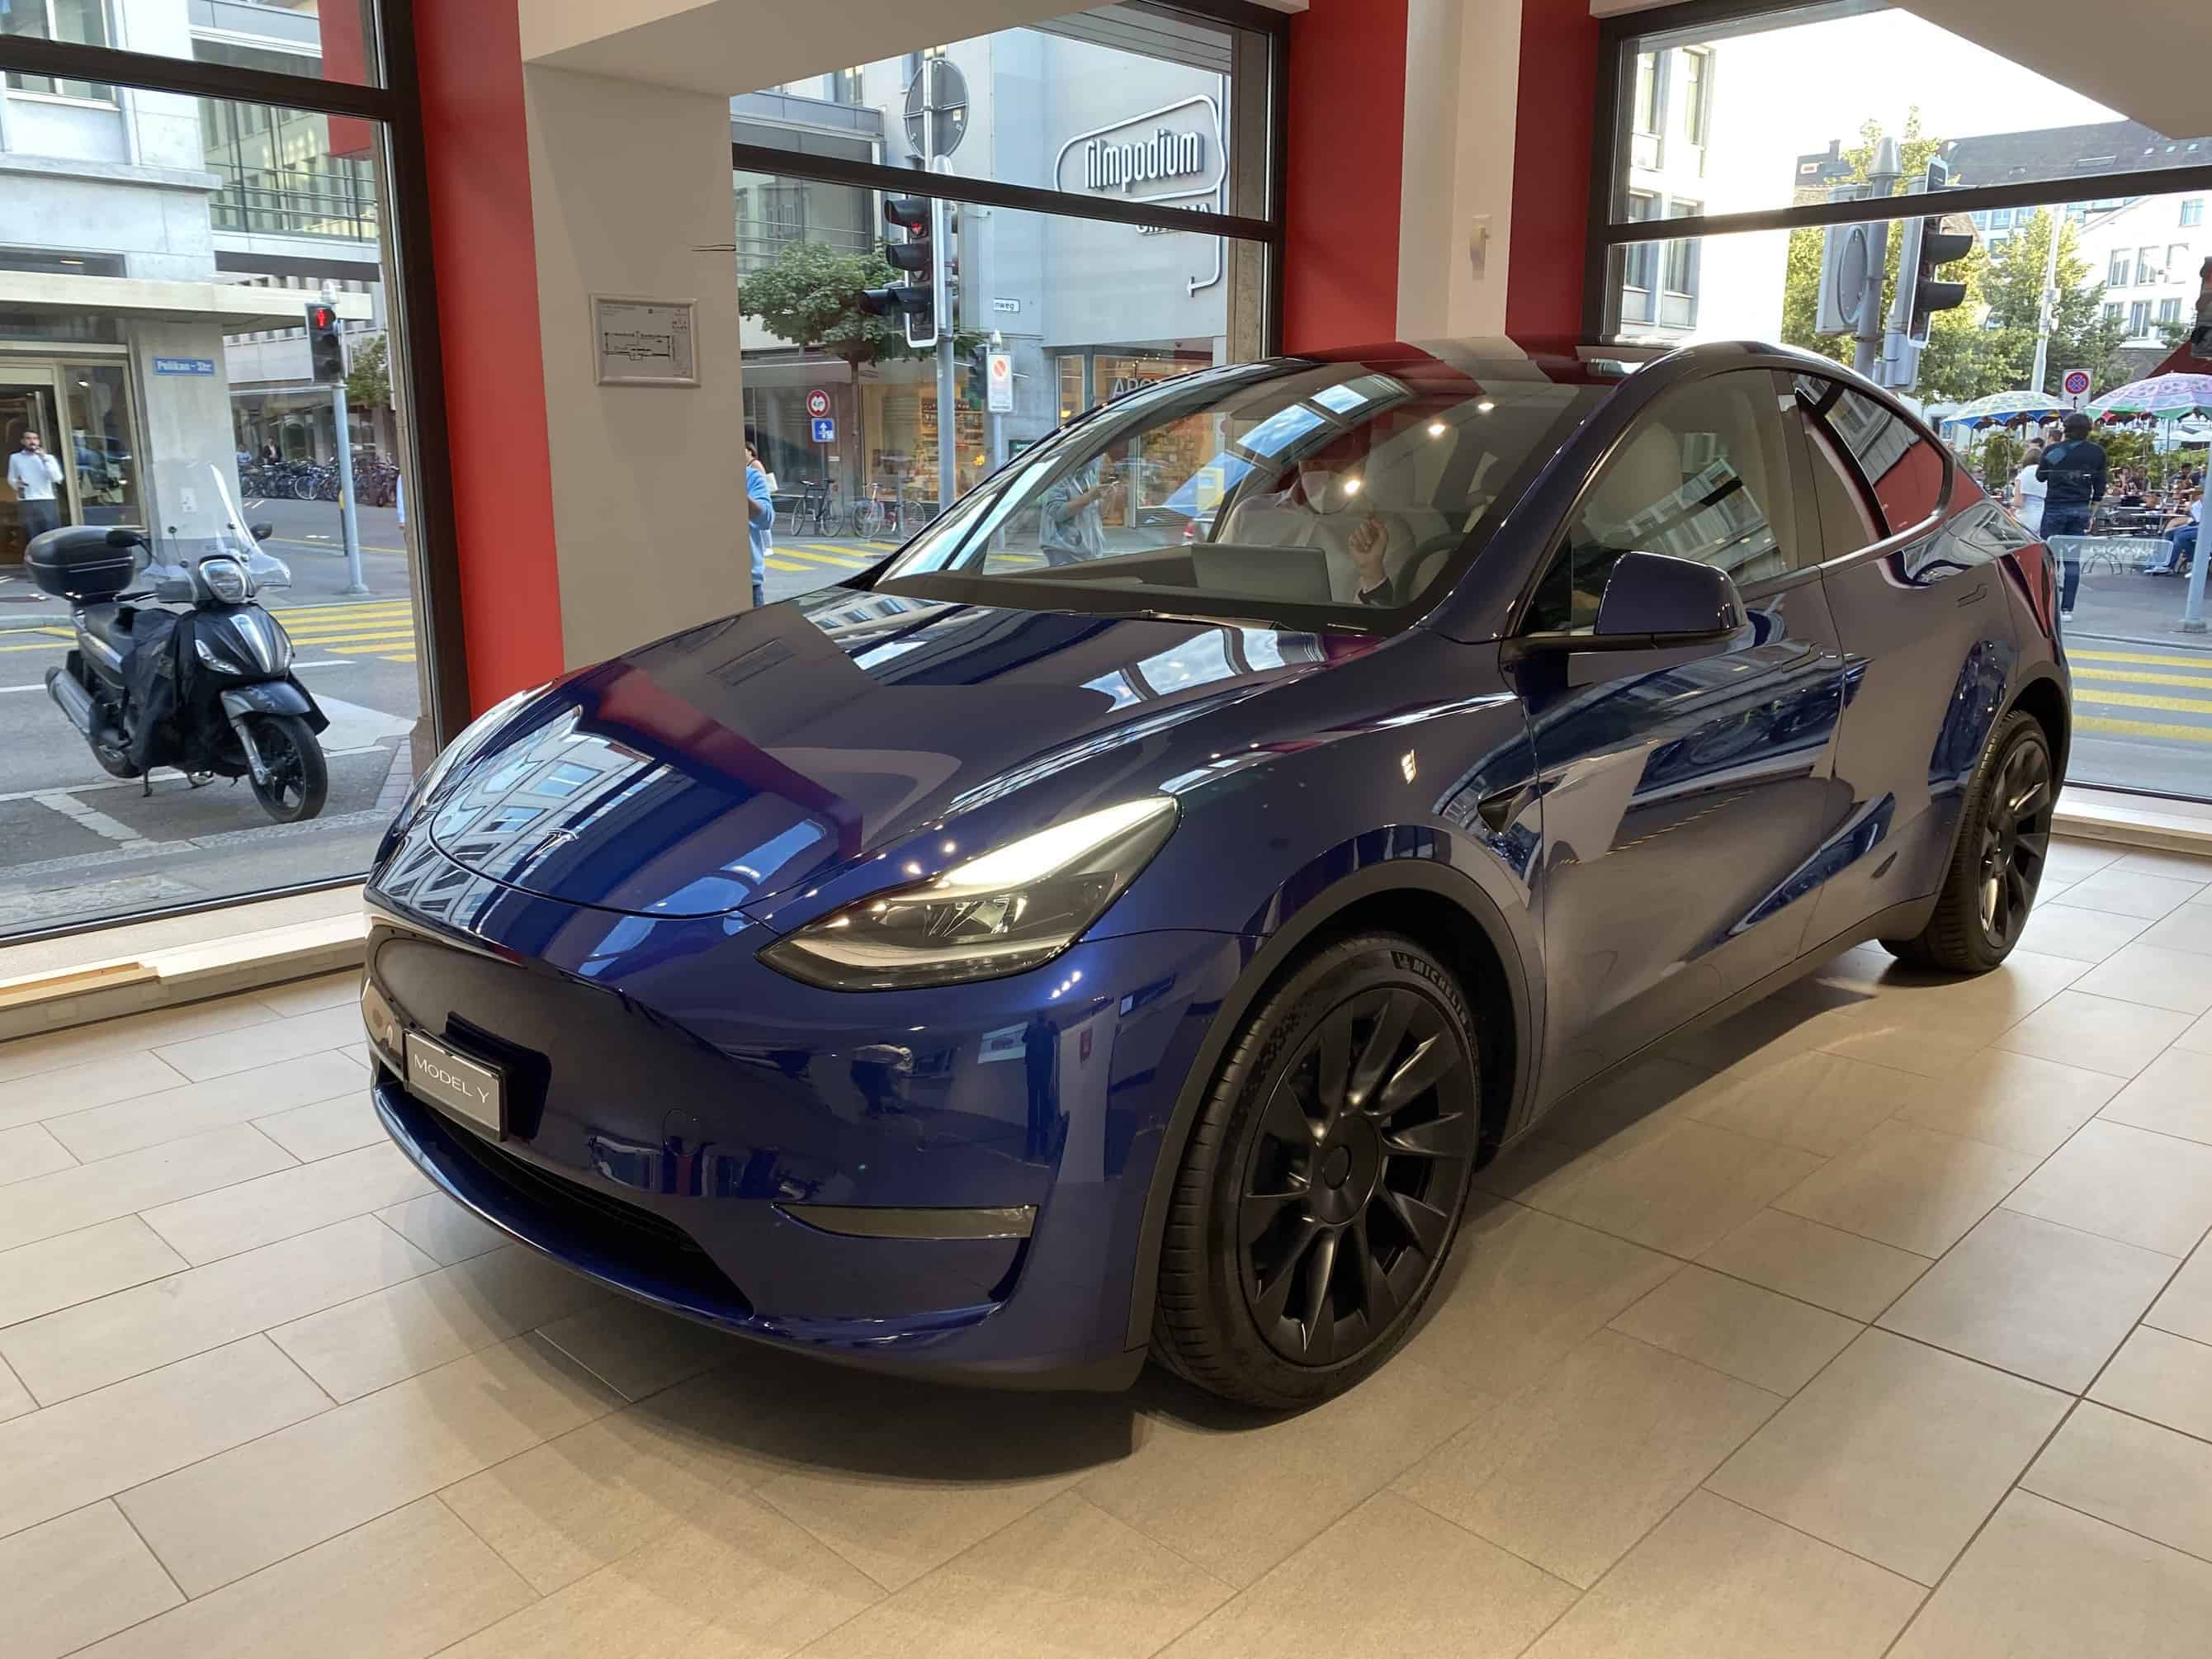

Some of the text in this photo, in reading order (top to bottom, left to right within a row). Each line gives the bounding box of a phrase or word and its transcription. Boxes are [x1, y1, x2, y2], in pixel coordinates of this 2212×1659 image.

[1085, 129, 1200, 192] filmpodium
[1412, 958, 1467, 1025] MICHELIN
[414, 1053, 489, 1104] MODEL Y
